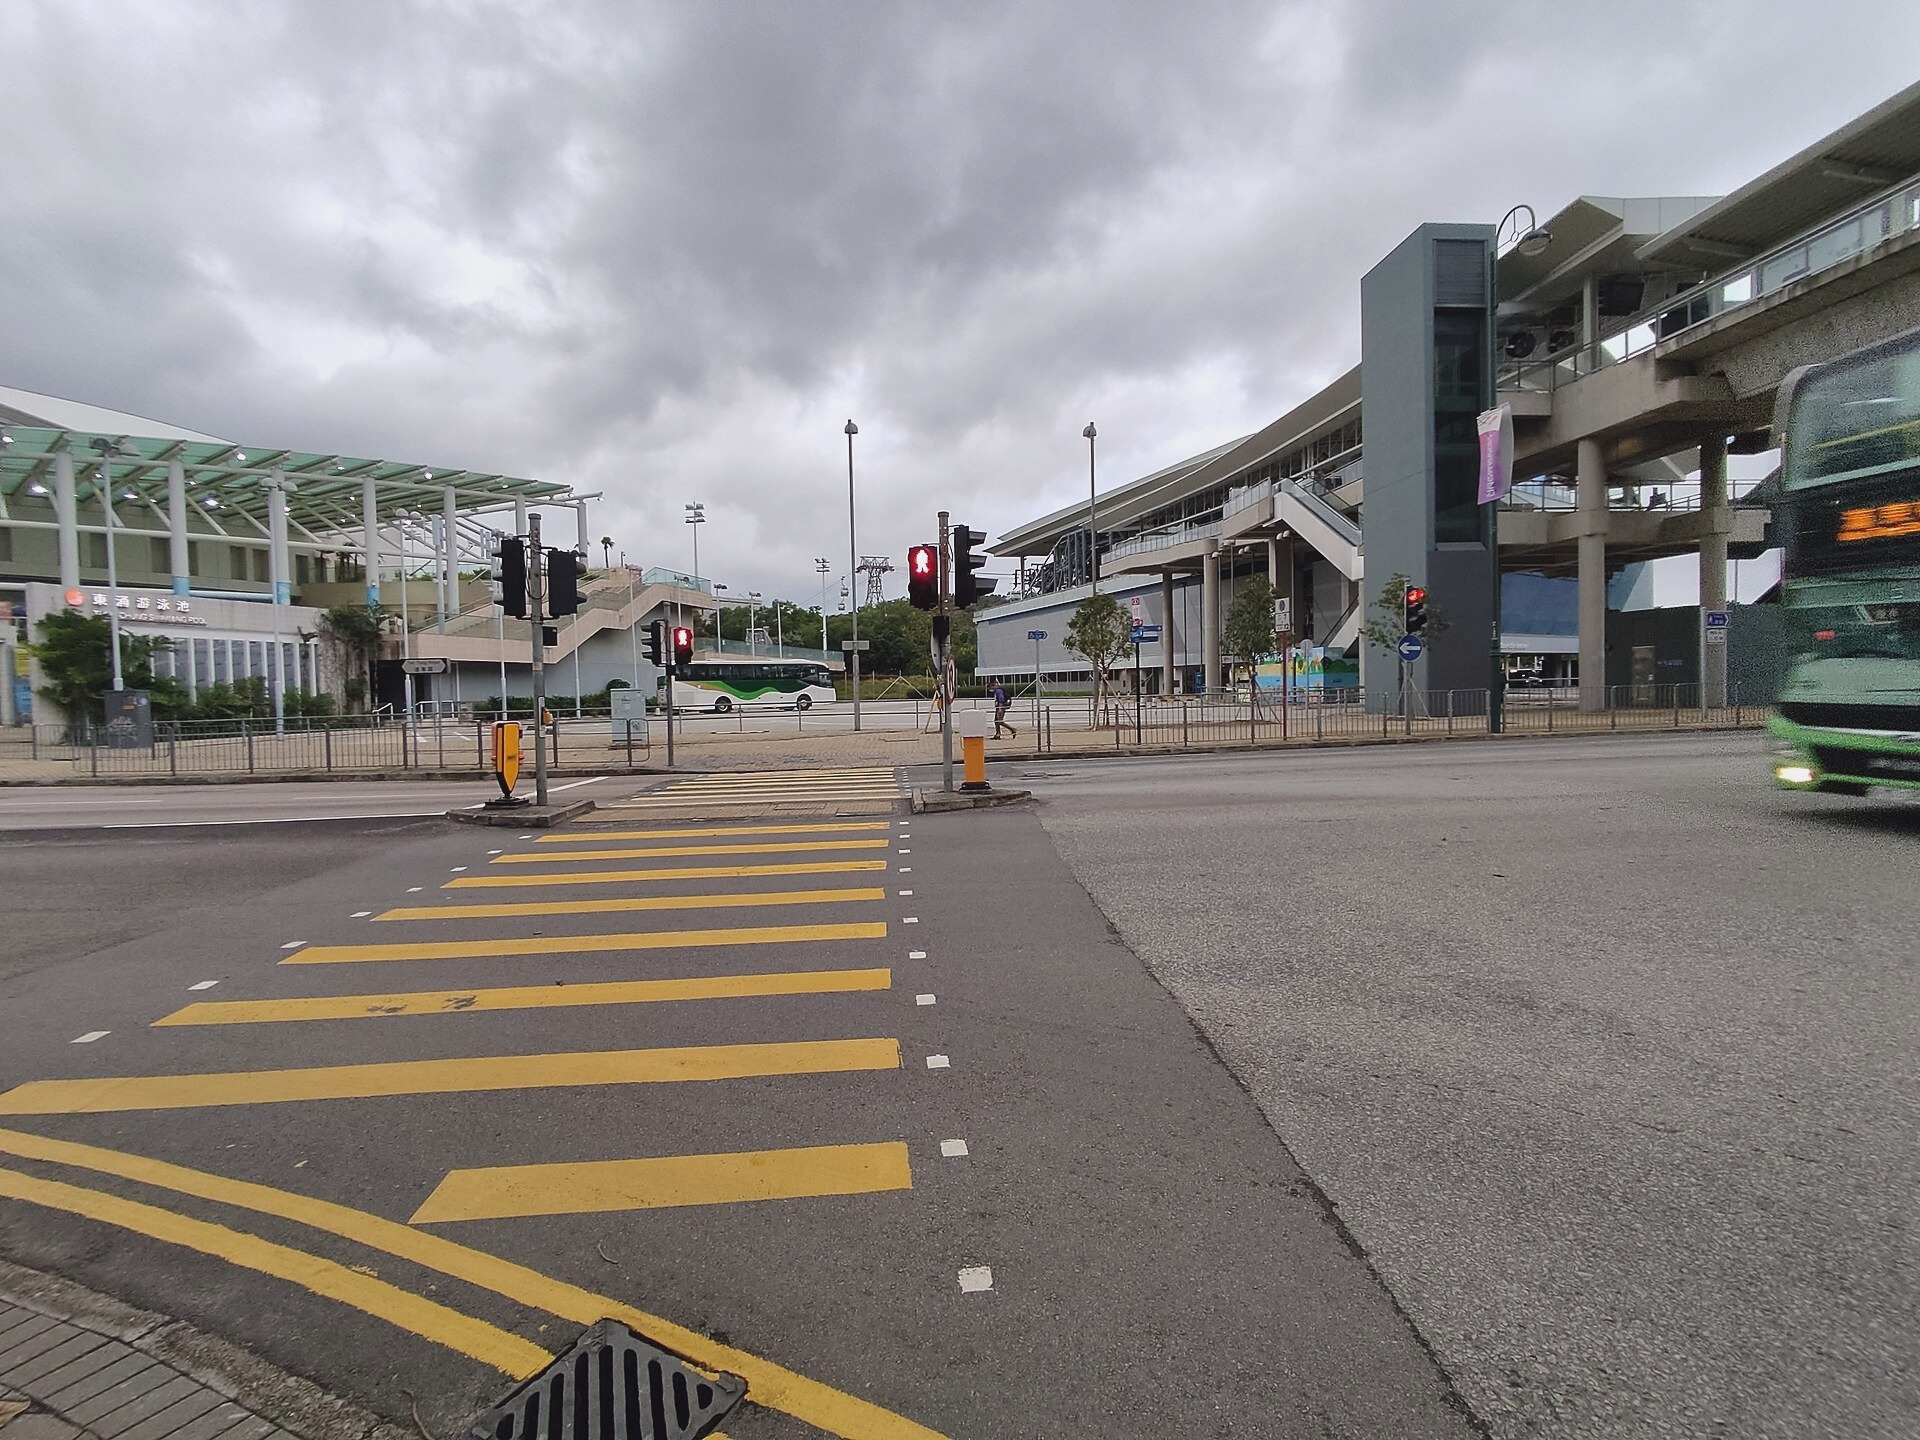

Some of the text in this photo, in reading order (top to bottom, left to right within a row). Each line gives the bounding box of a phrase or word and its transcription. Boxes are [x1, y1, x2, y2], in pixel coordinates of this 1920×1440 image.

[92, 593, 190, 612] 東涌游泳池
[187, 617, 208, 625] POOL
